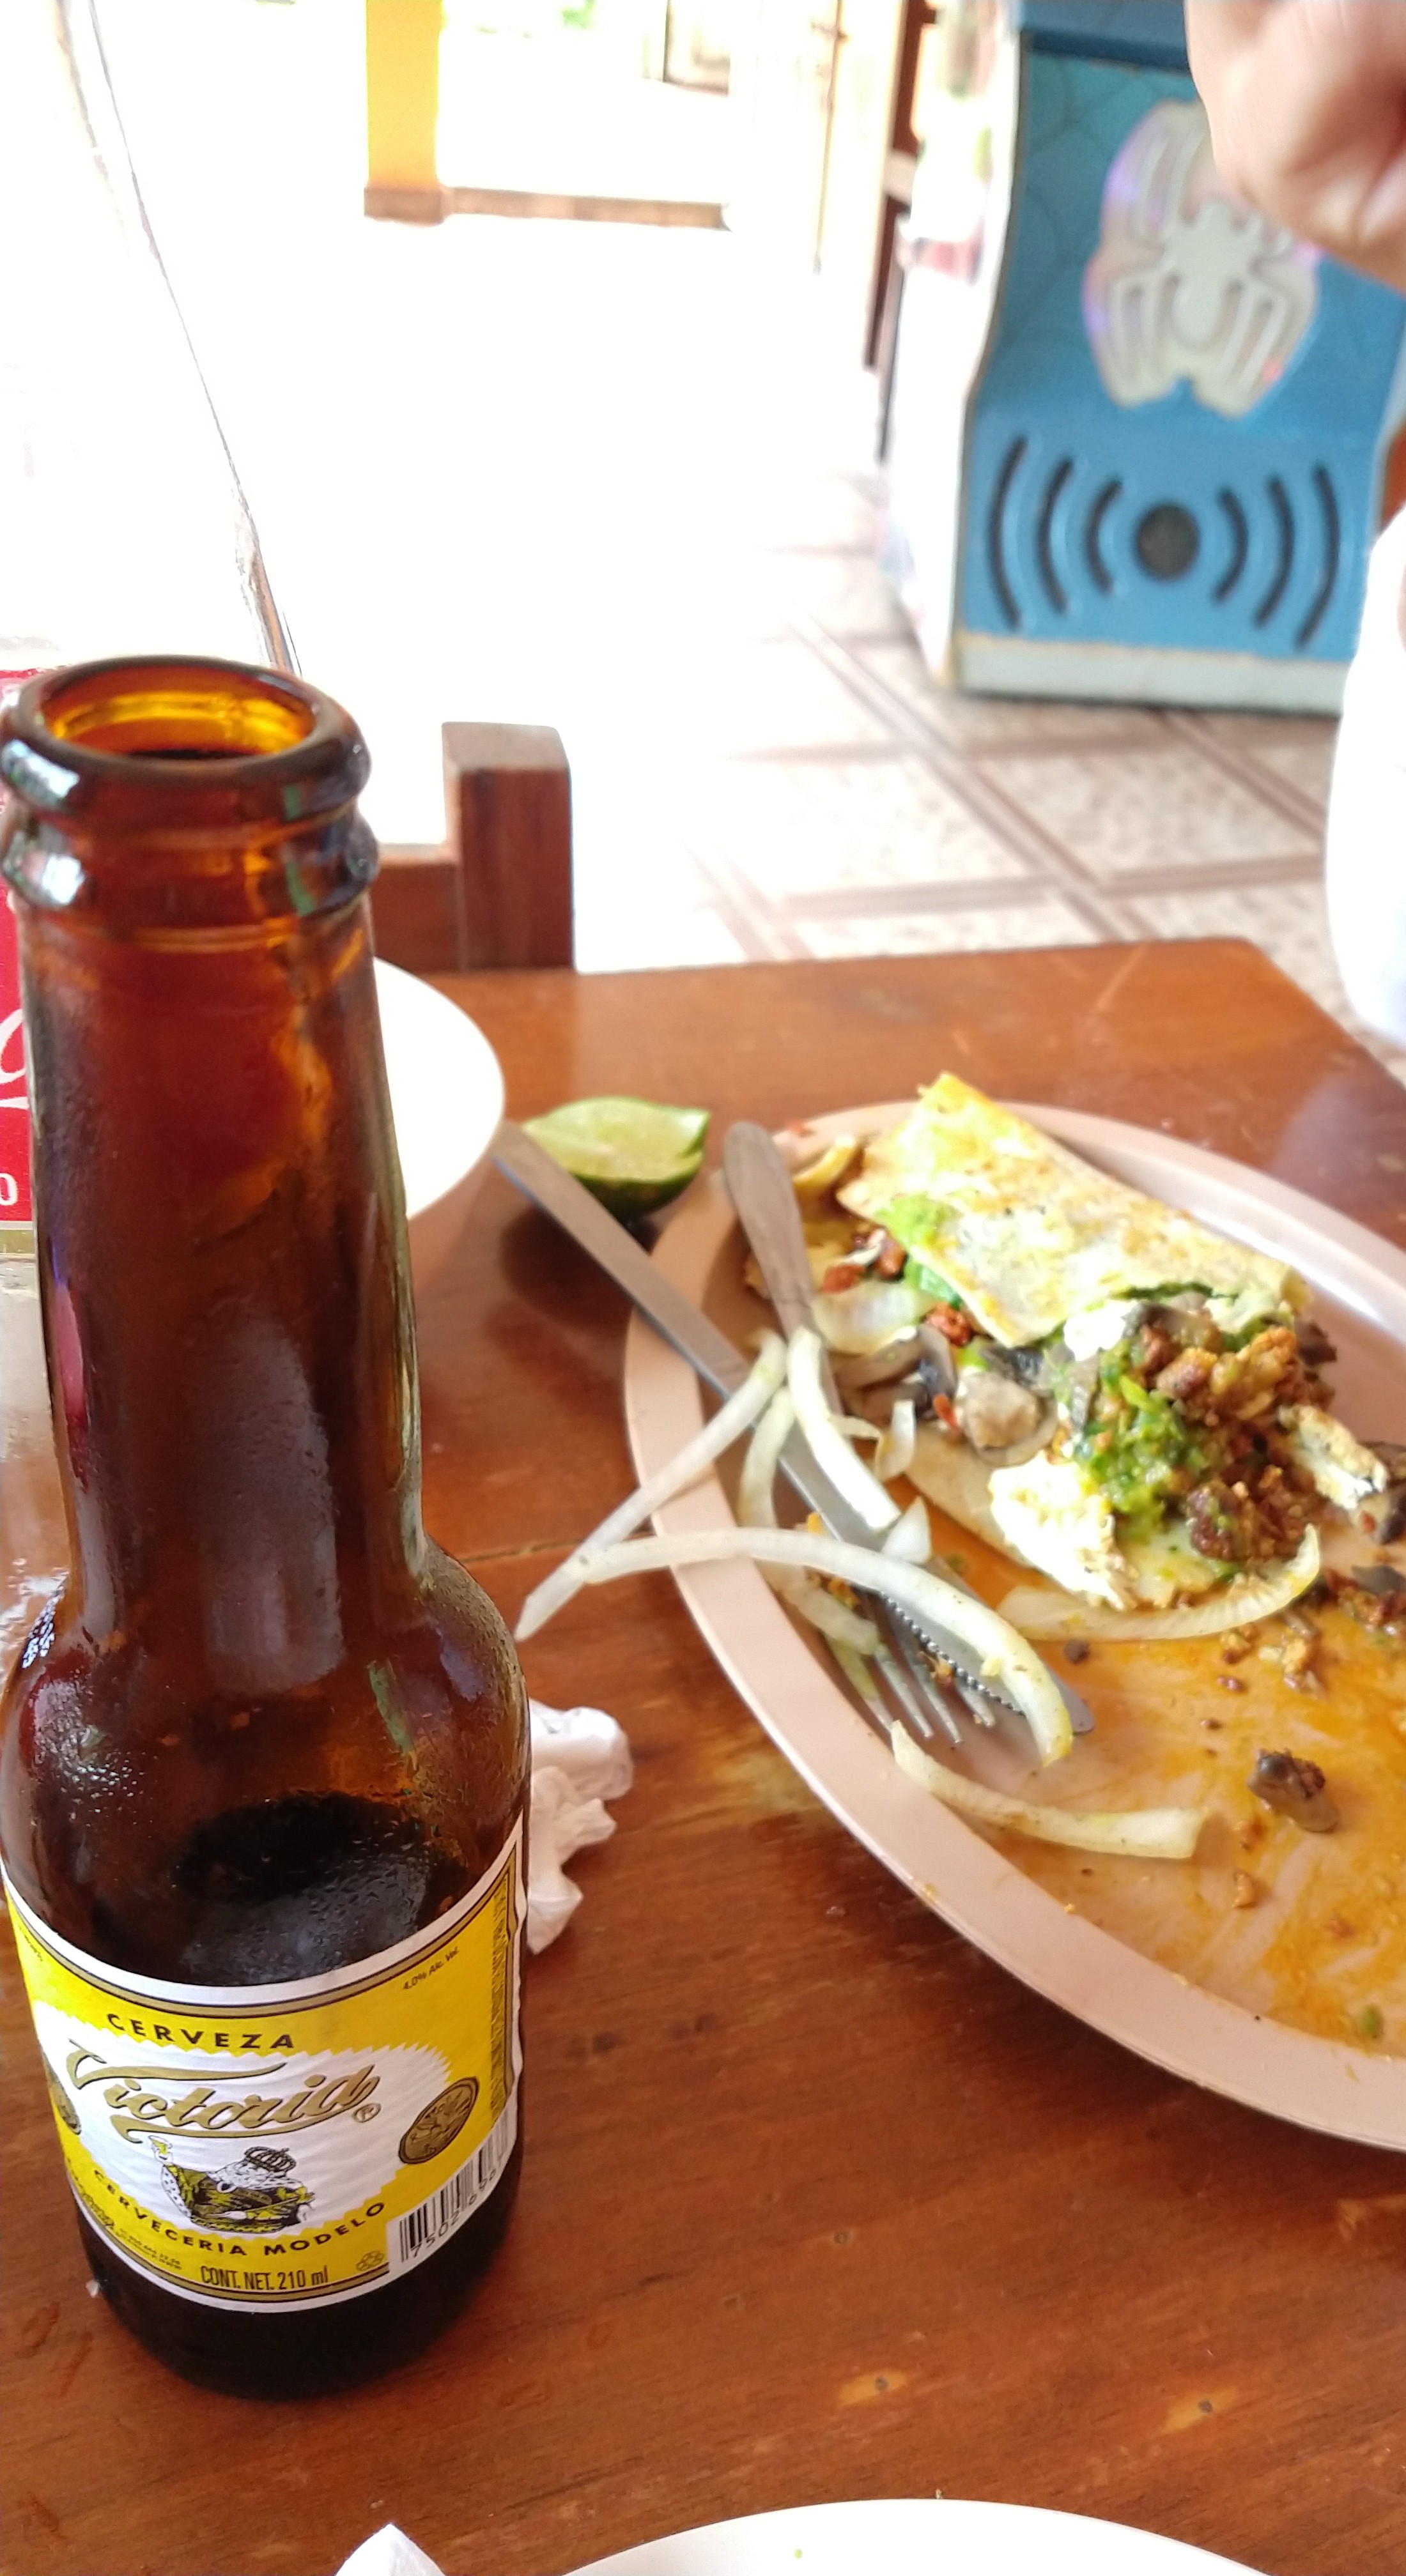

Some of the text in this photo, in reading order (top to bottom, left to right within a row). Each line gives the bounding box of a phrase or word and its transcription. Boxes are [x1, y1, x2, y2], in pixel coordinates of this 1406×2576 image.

[107, 2012, 295, 2050] CERVEZA
[66, 2038, 381, 2143] Victoria
[94, 2169, 247, 2257] CERVECERIA
[263, 2202, 385, 2257] MODELO
[200, 2265, 329, 2291] CONT. NET. 210 ml
